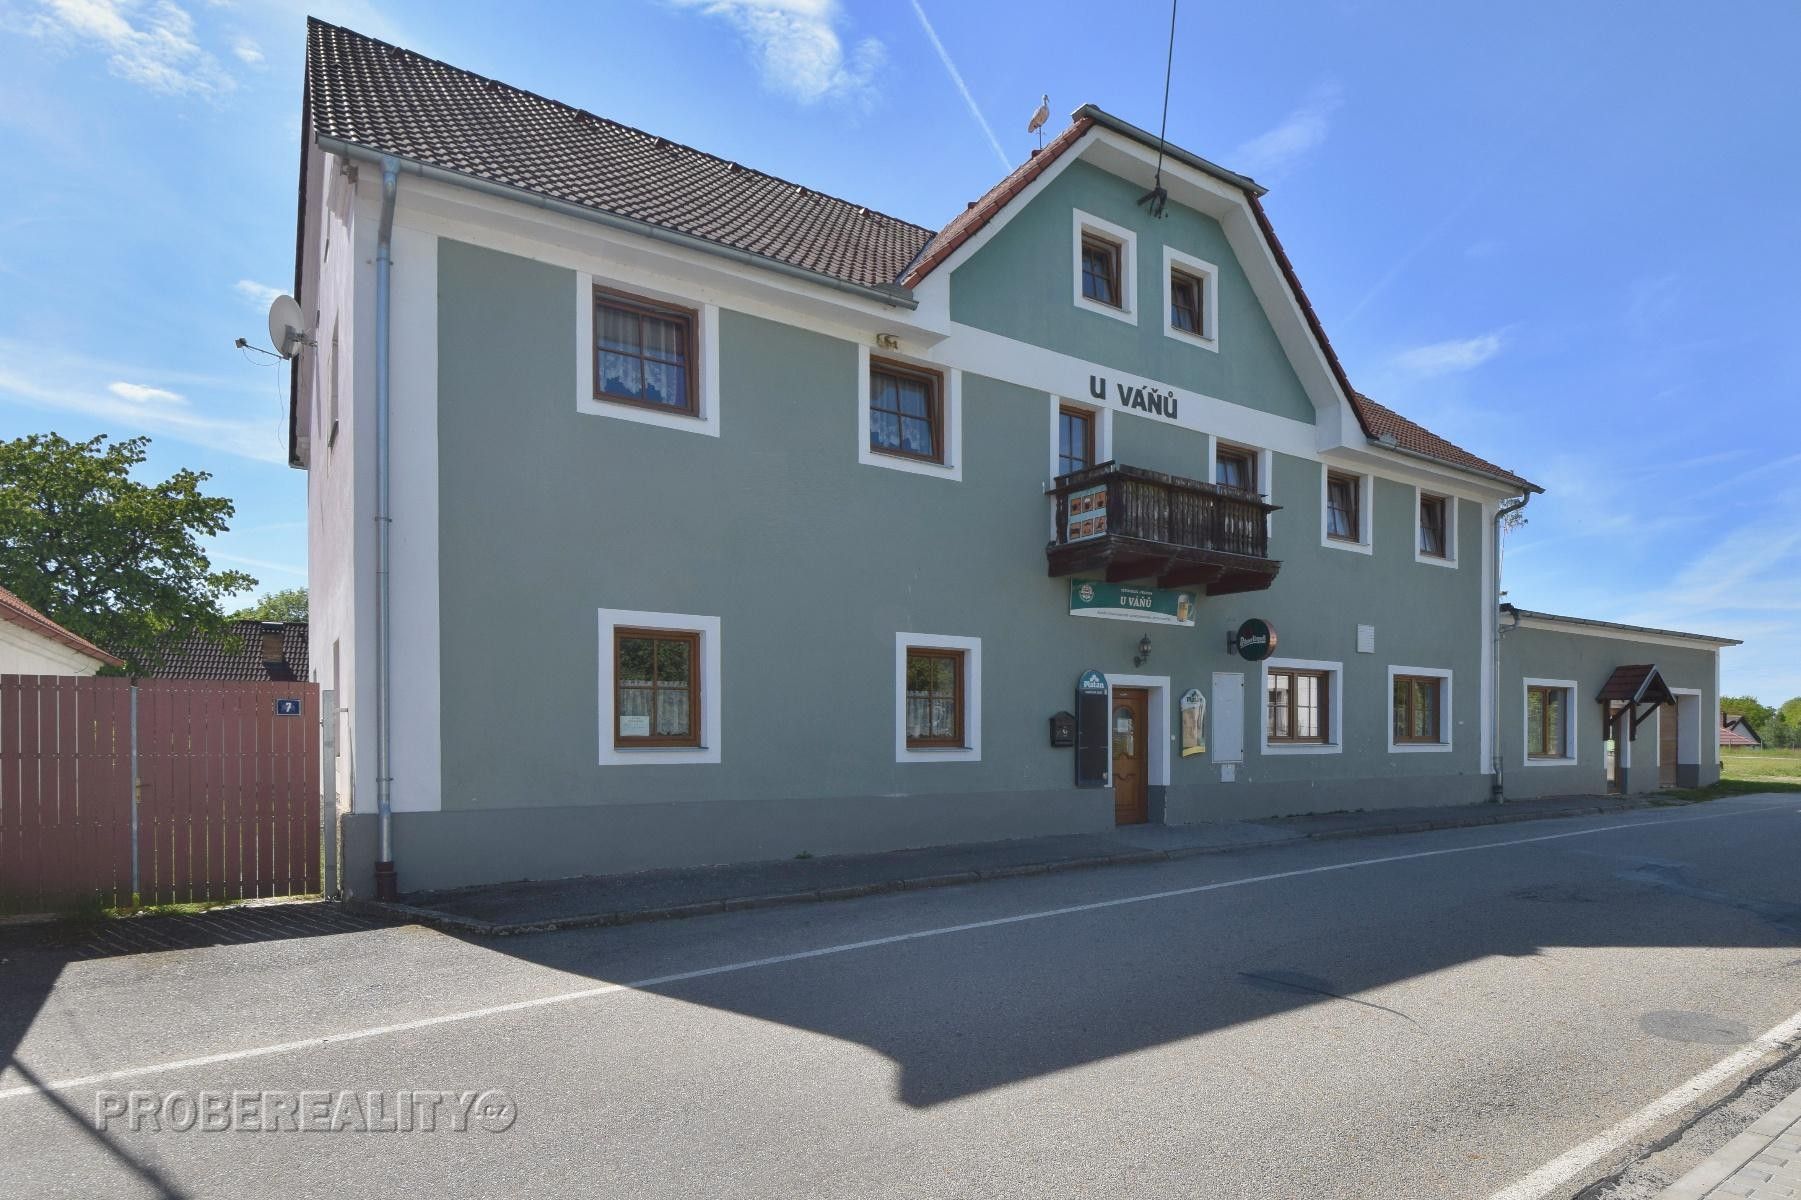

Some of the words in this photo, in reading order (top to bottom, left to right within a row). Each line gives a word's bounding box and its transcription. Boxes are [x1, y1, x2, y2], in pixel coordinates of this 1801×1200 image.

[1089, 375, 1106, 400] U
[1116, 384, 1178, 420] VÁŇŮ
[1120, 596, 1127, 606] U
[285, 702, 292, 713] 7
